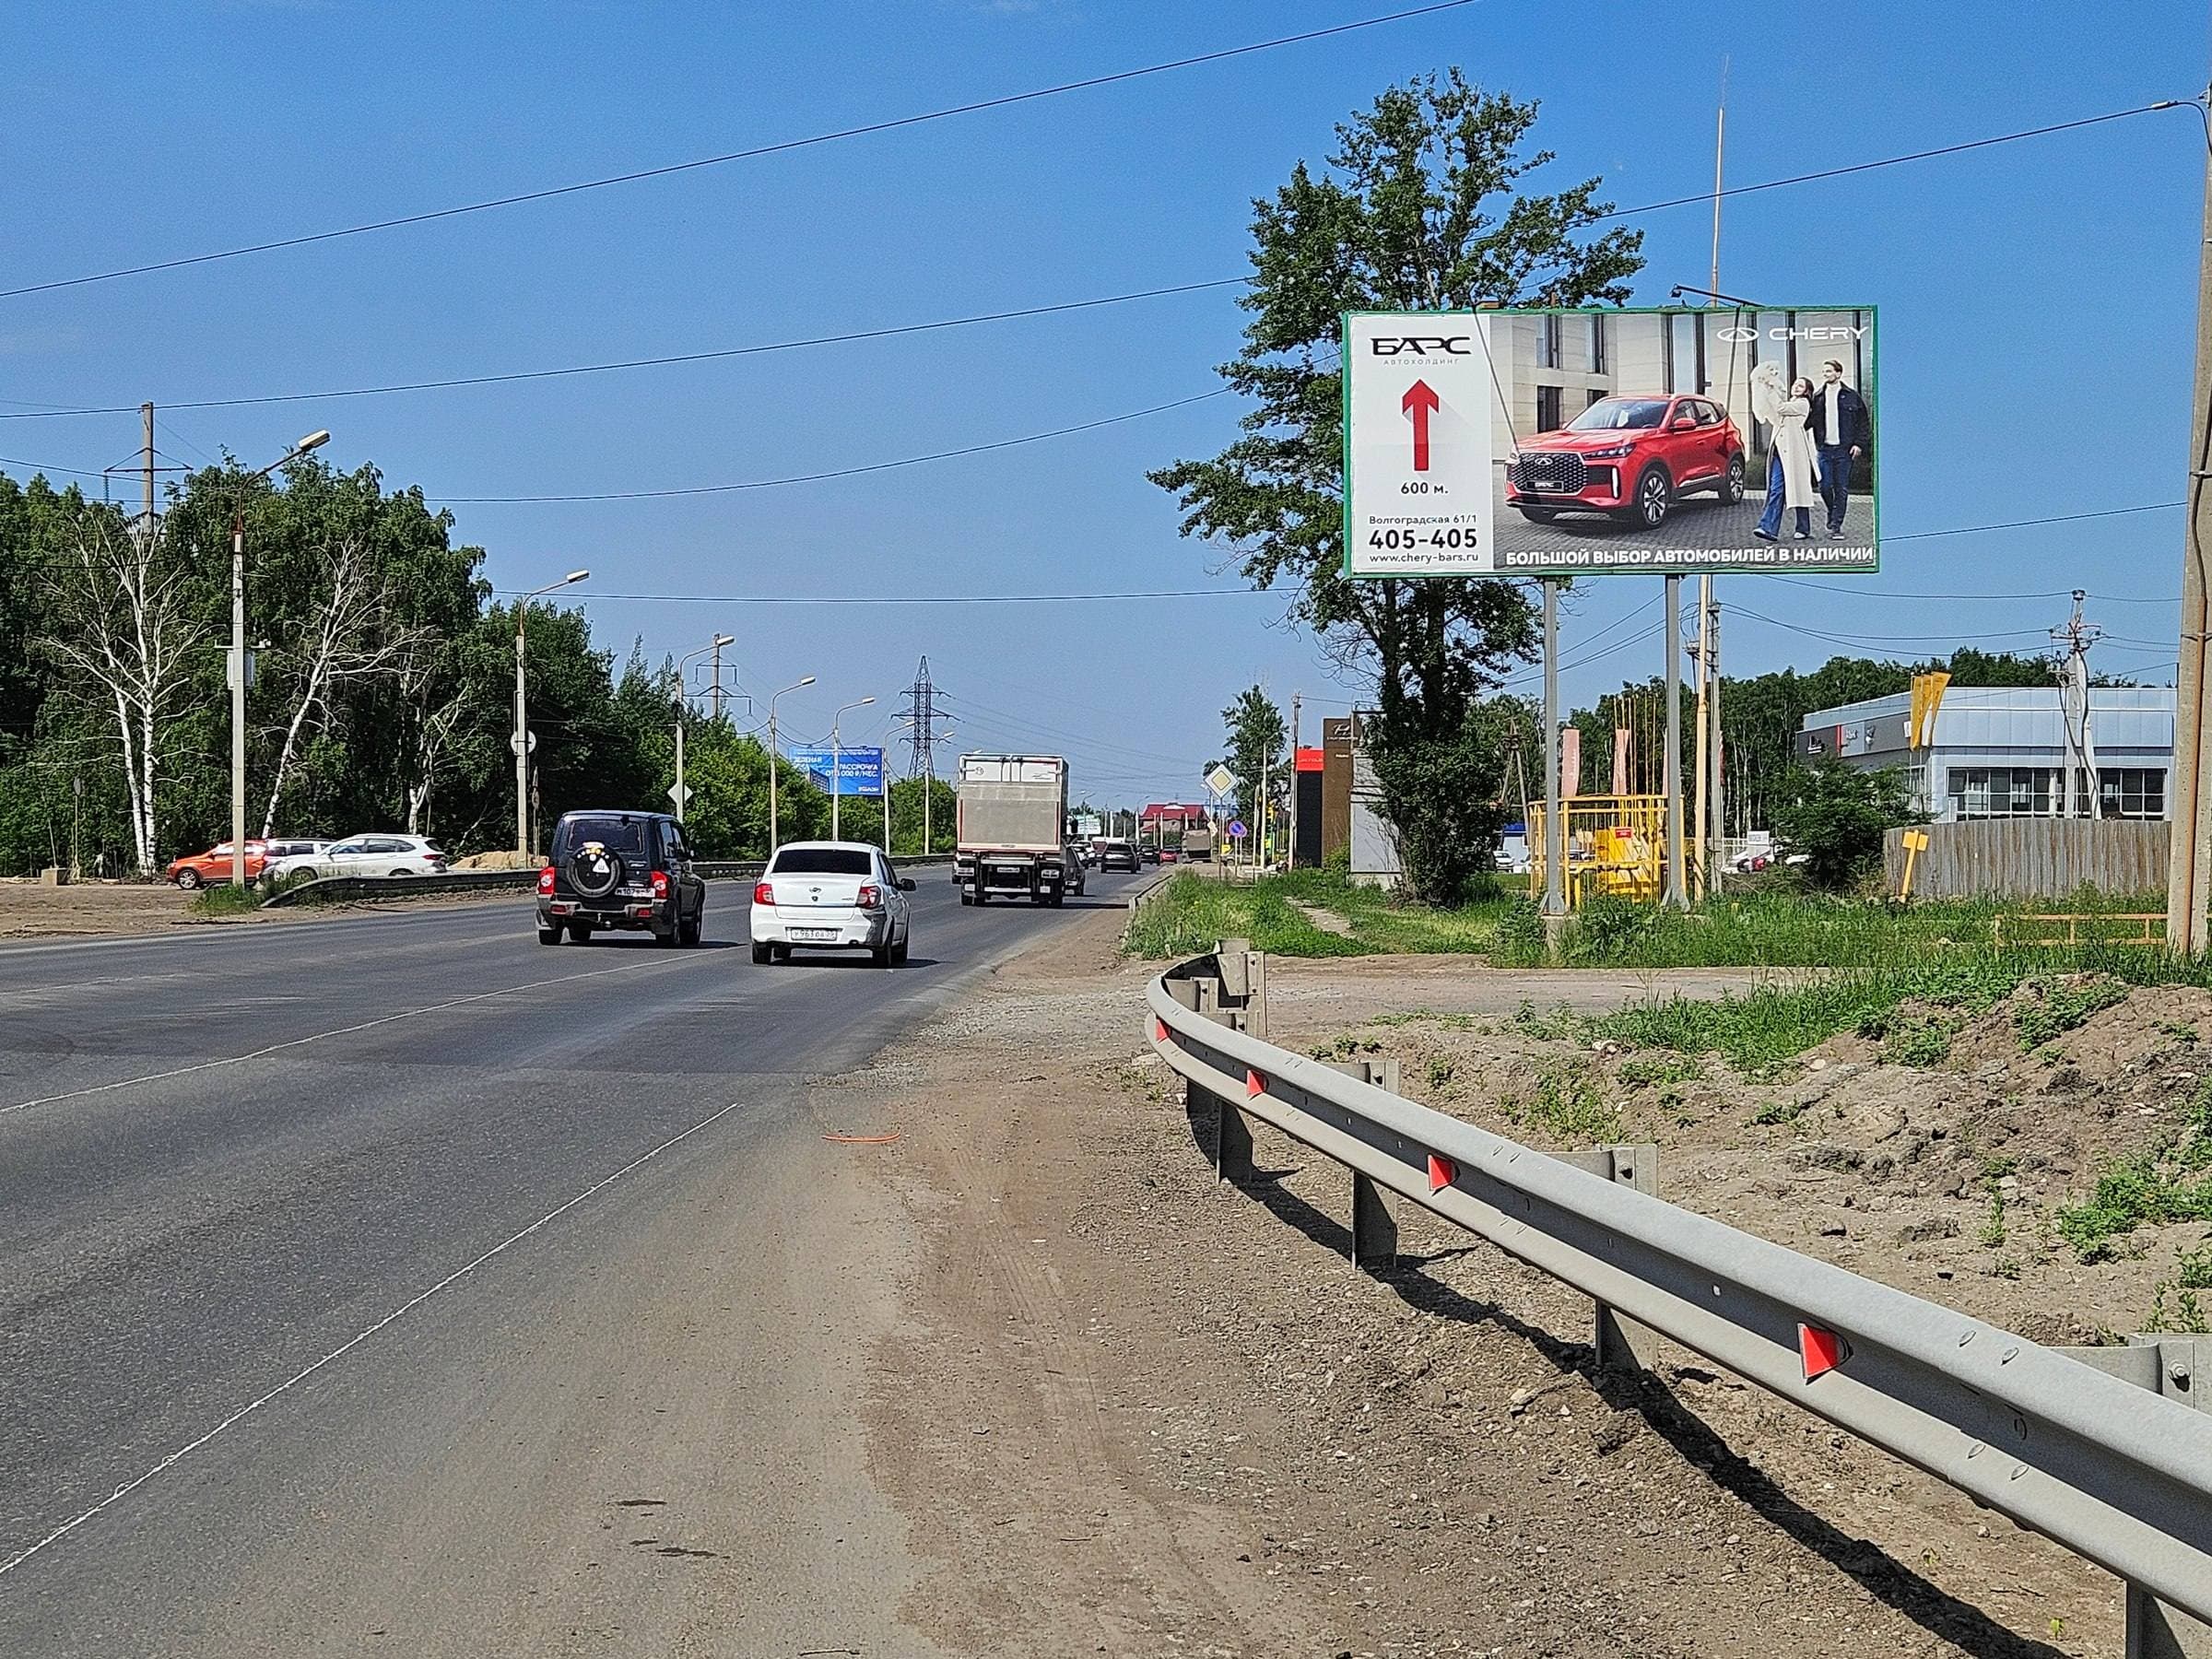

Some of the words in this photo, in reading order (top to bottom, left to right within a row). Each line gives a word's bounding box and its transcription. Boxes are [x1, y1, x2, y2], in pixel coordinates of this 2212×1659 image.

[1769, 326, 1869, 340] CHERY
[1370, 336, 1472, 356] БАРС
[1400, 482, 1429, 495] 600
[1433, 485, 1449, 494] м.
[1369, 515, 1450, 525] Волгоградская
[1453, 514, 1477, 524] 61/1
[1369, 528, 1477, 550] 405-405
[1370, 553, 1479, 564] www.chery-bars.ru
[1506, 548, 1589, 566] БОЛЬШОЙ
[1593, 550, 1651, 564] ВЫБОР
[1653, 546, 1775, 564] АВТОМОБИЛЕЙ
[1779, 548, 1790, 561] В
[1794, 547, 1873, 561] НАЛИЧИИ
